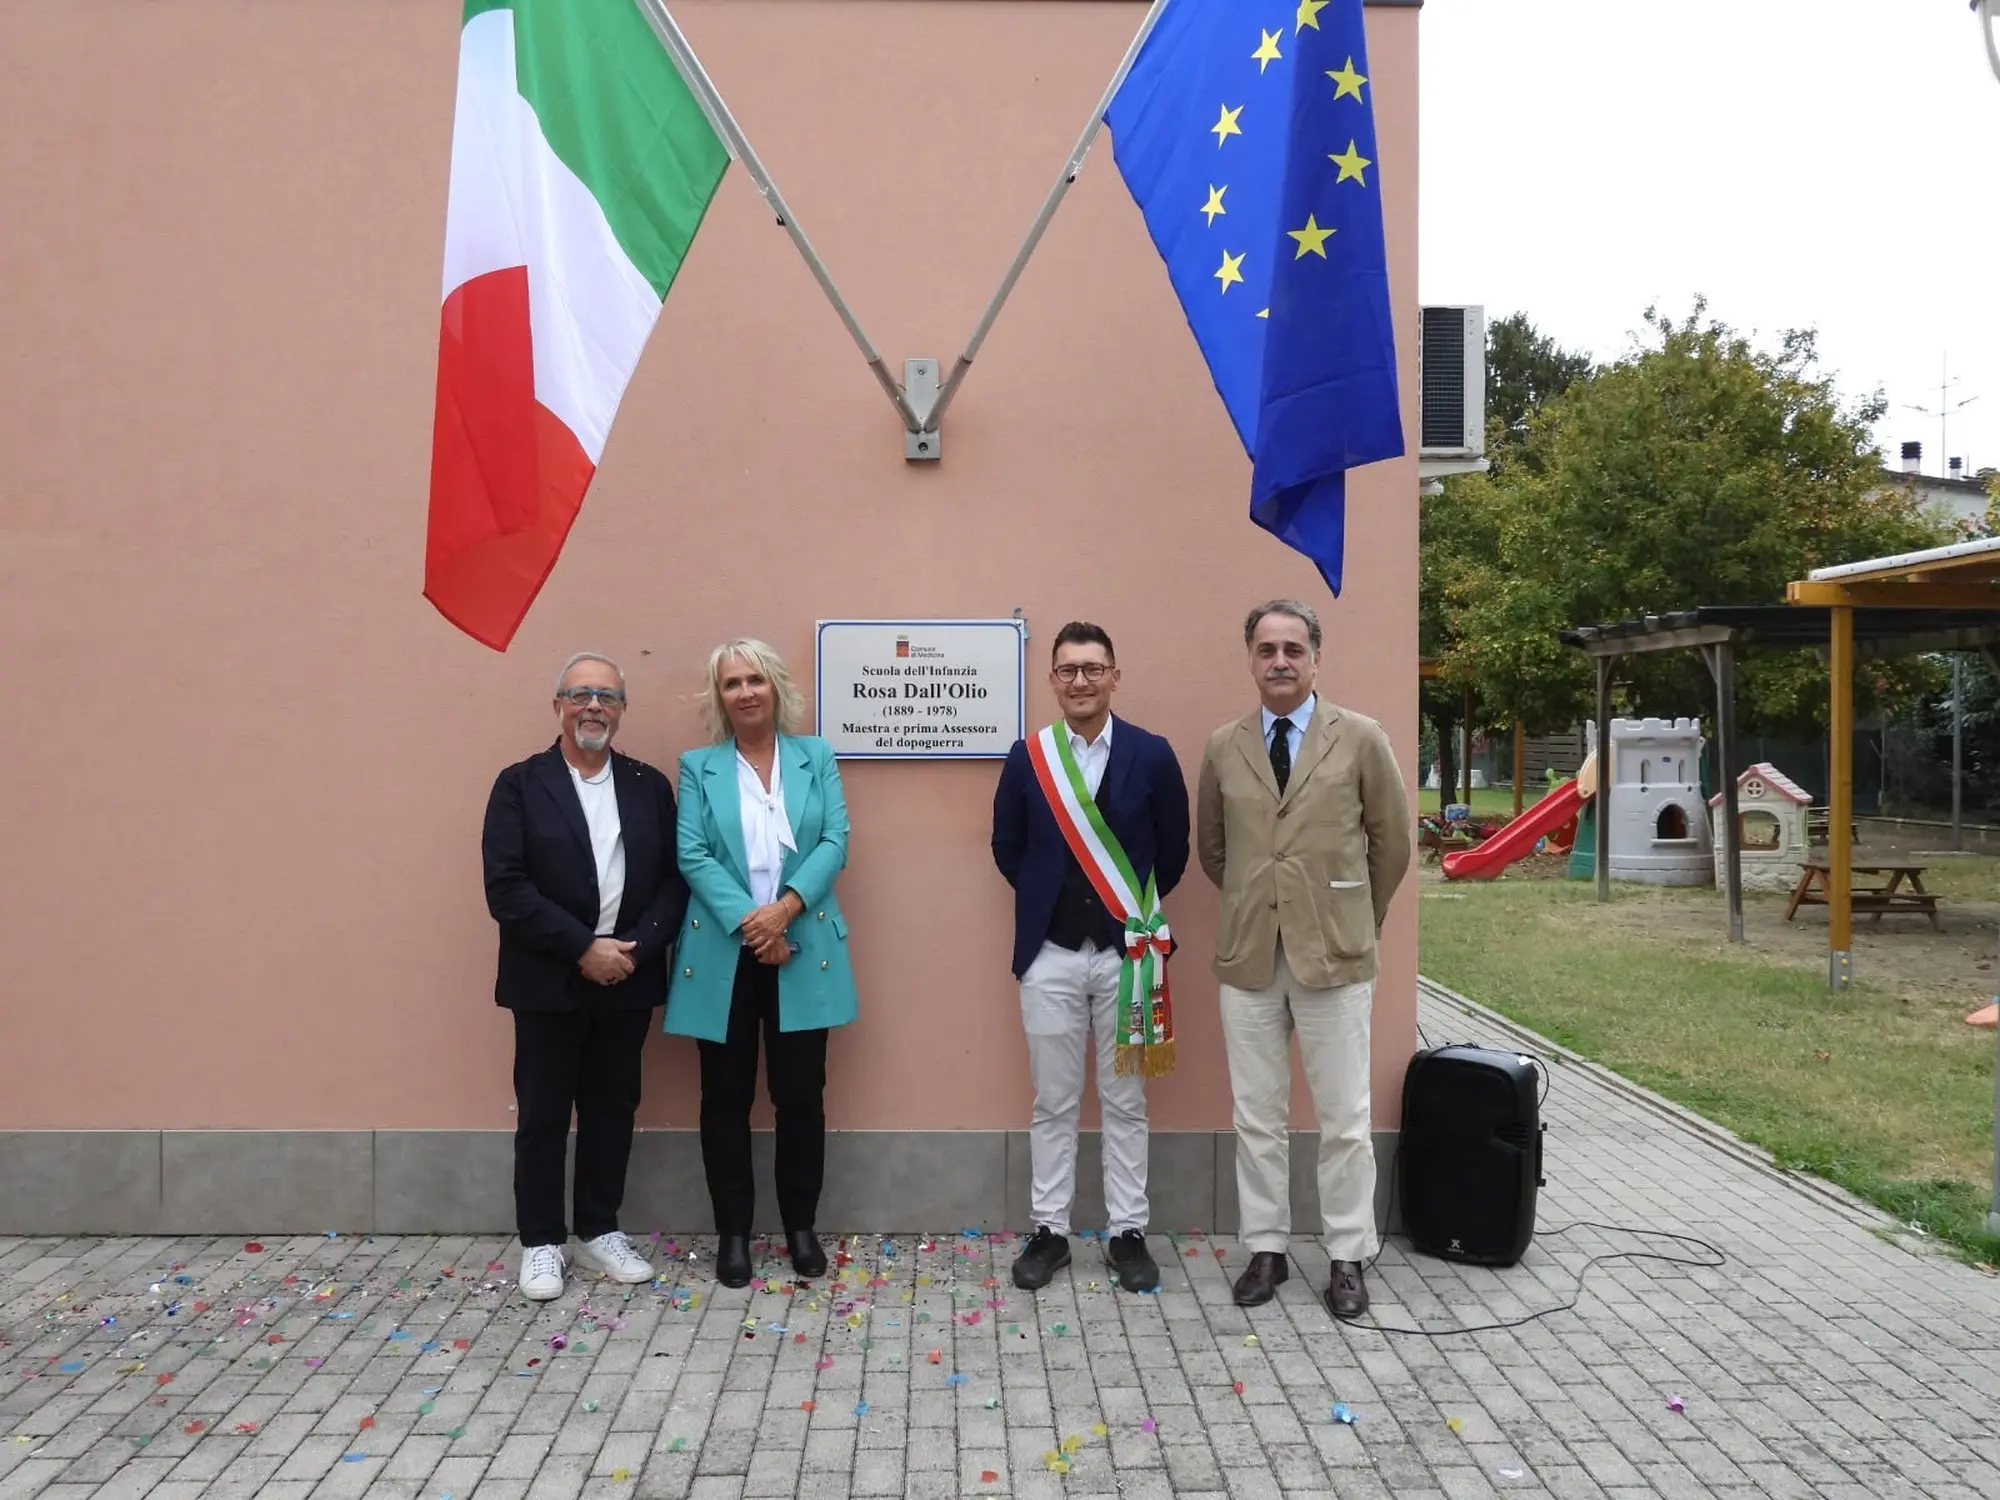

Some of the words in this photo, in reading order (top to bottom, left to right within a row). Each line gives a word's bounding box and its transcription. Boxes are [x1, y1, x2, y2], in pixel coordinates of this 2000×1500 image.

[862, 666, 900, 676] Scuola
[904, 665, 977, 676] dell'Infanzia
[853, 683, 897, 699] Rosa
[904, 683, 988, 699] Dall'Olio
[882, 706, 914, 718] (1889
[926, 706, 958, 718] 1978)
[842, 723, 890, 734] Maestra
[894, 726, 900, 734] e
[904, 723, 938, 737] prima
[941, 723, 998, 734] Assessora
[876, 737, 893, 748] del
[897, 737, 964, 751] dopoguerra
